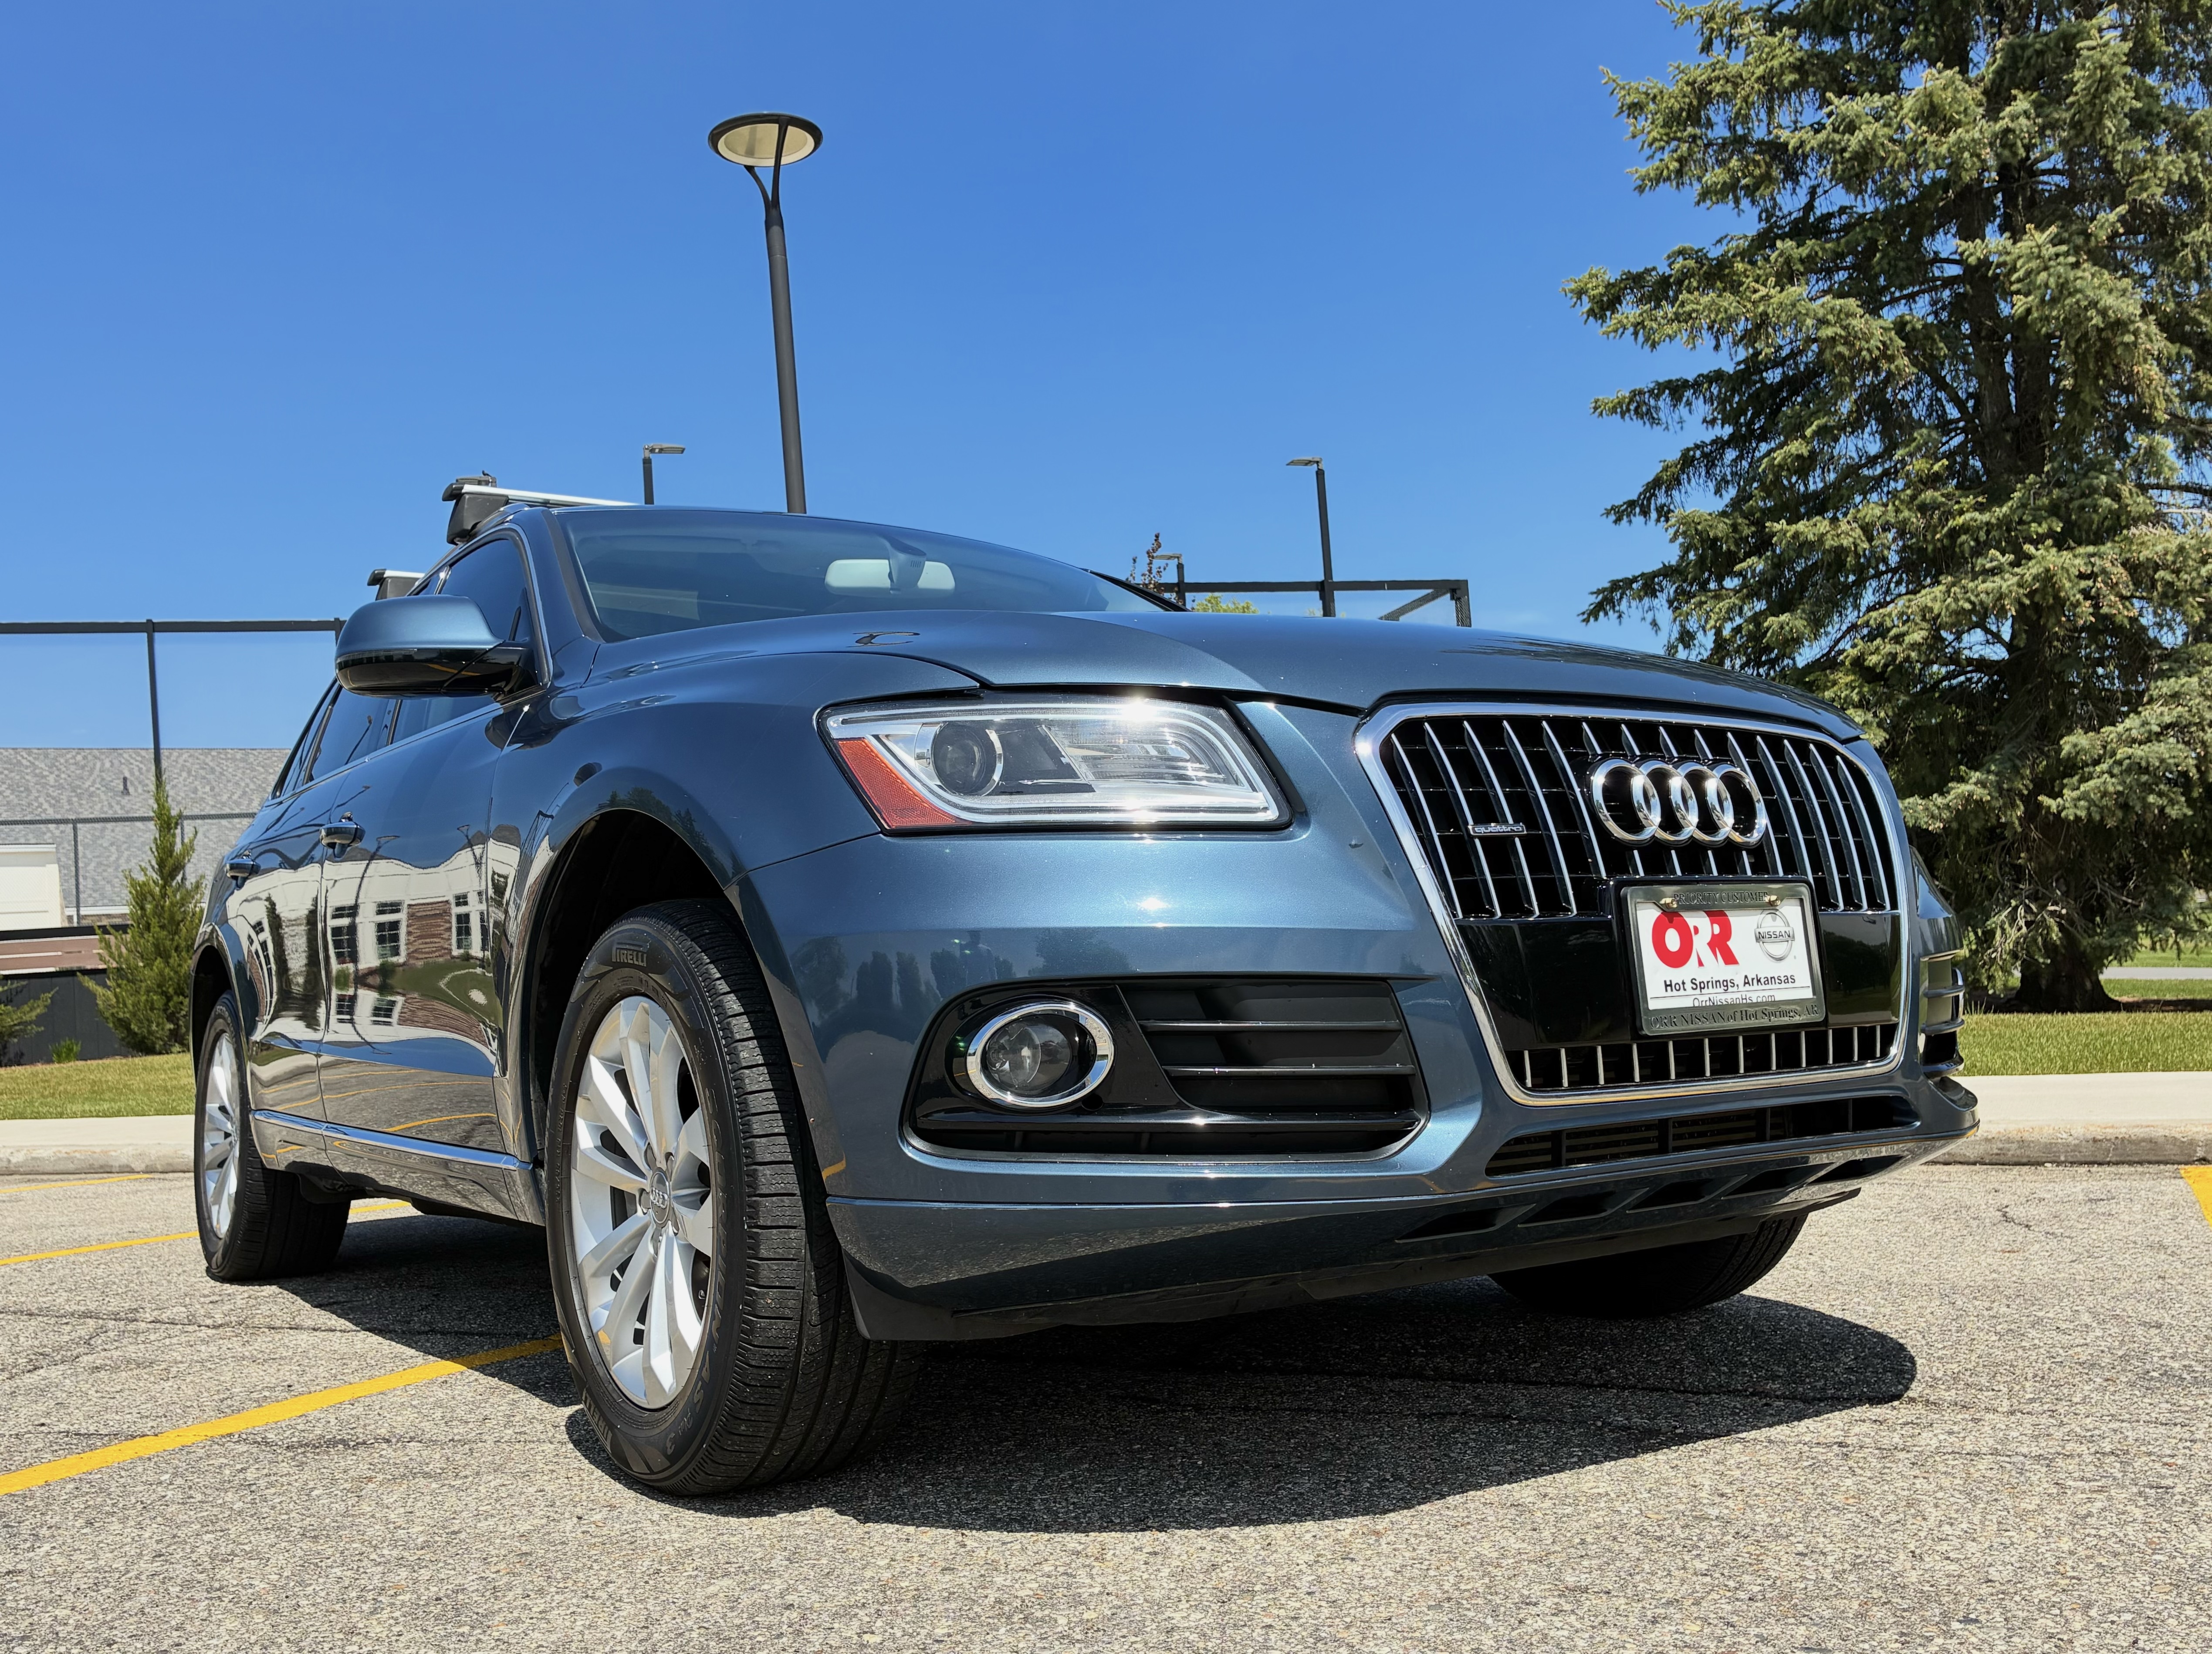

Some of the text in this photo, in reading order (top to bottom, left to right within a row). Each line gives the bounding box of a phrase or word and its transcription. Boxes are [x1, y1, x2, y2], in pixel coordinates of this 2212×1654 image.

[1674, 891, 1720, 905] PRIORITY
[1652, 910, 1739, 968] ORR
[1758, 930, 1791, 939] NISSAN
[612, 940, 648, 966] PIRELLI
[1664, 974, 1796, 993] Hot Springs, Arkansas
[1693, 994, 1776, 1007] OrrNissanHscom
[1651, 1015, 1678, 1030] ORR
[1681, 1012, 1726, 1026] NISSAN
[1727, 1010, 1738, 1022] of
[1740, 1009, 1758, 1021] Hot
[1803, 1004, 1819, 1016] AR
